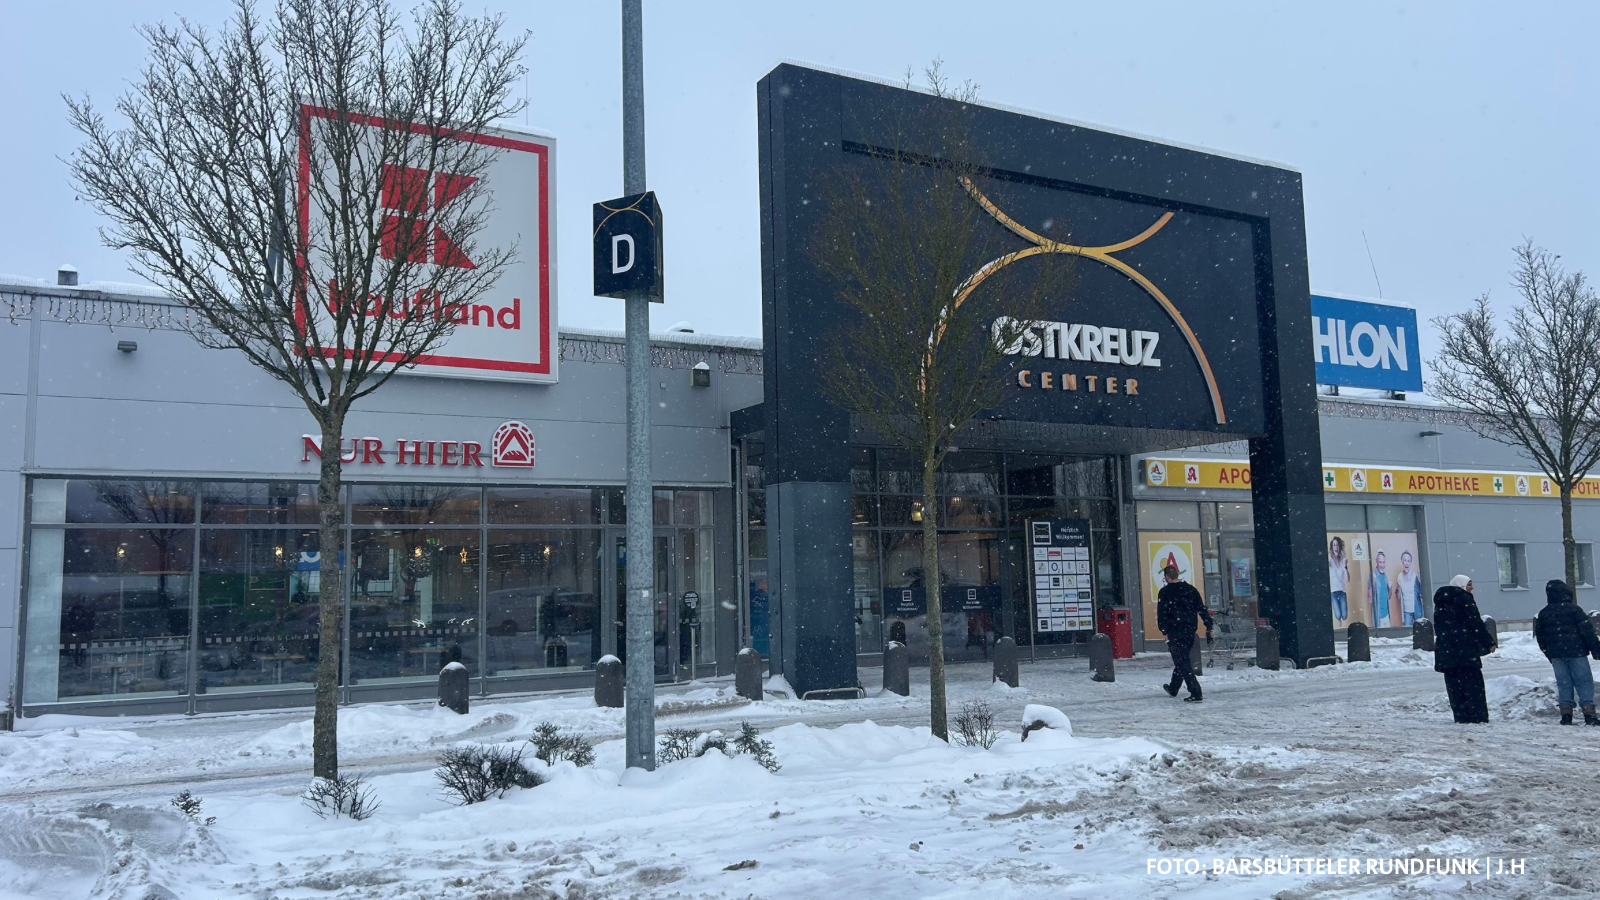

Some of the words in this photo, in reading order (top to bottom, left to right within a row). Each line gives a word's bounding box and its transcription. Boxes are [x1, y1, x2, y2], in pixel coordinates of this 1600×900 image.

[611, 233, 635, 274] D
[991, 315, 1161, 367] OSTKREUZ
[1018, 369, 1138, 395] CENTER
[301, 434, 385, 465] NUR
[396, 438, 484, 467] HIER
[1408, 475, 1480, 492] APOTHEKE
